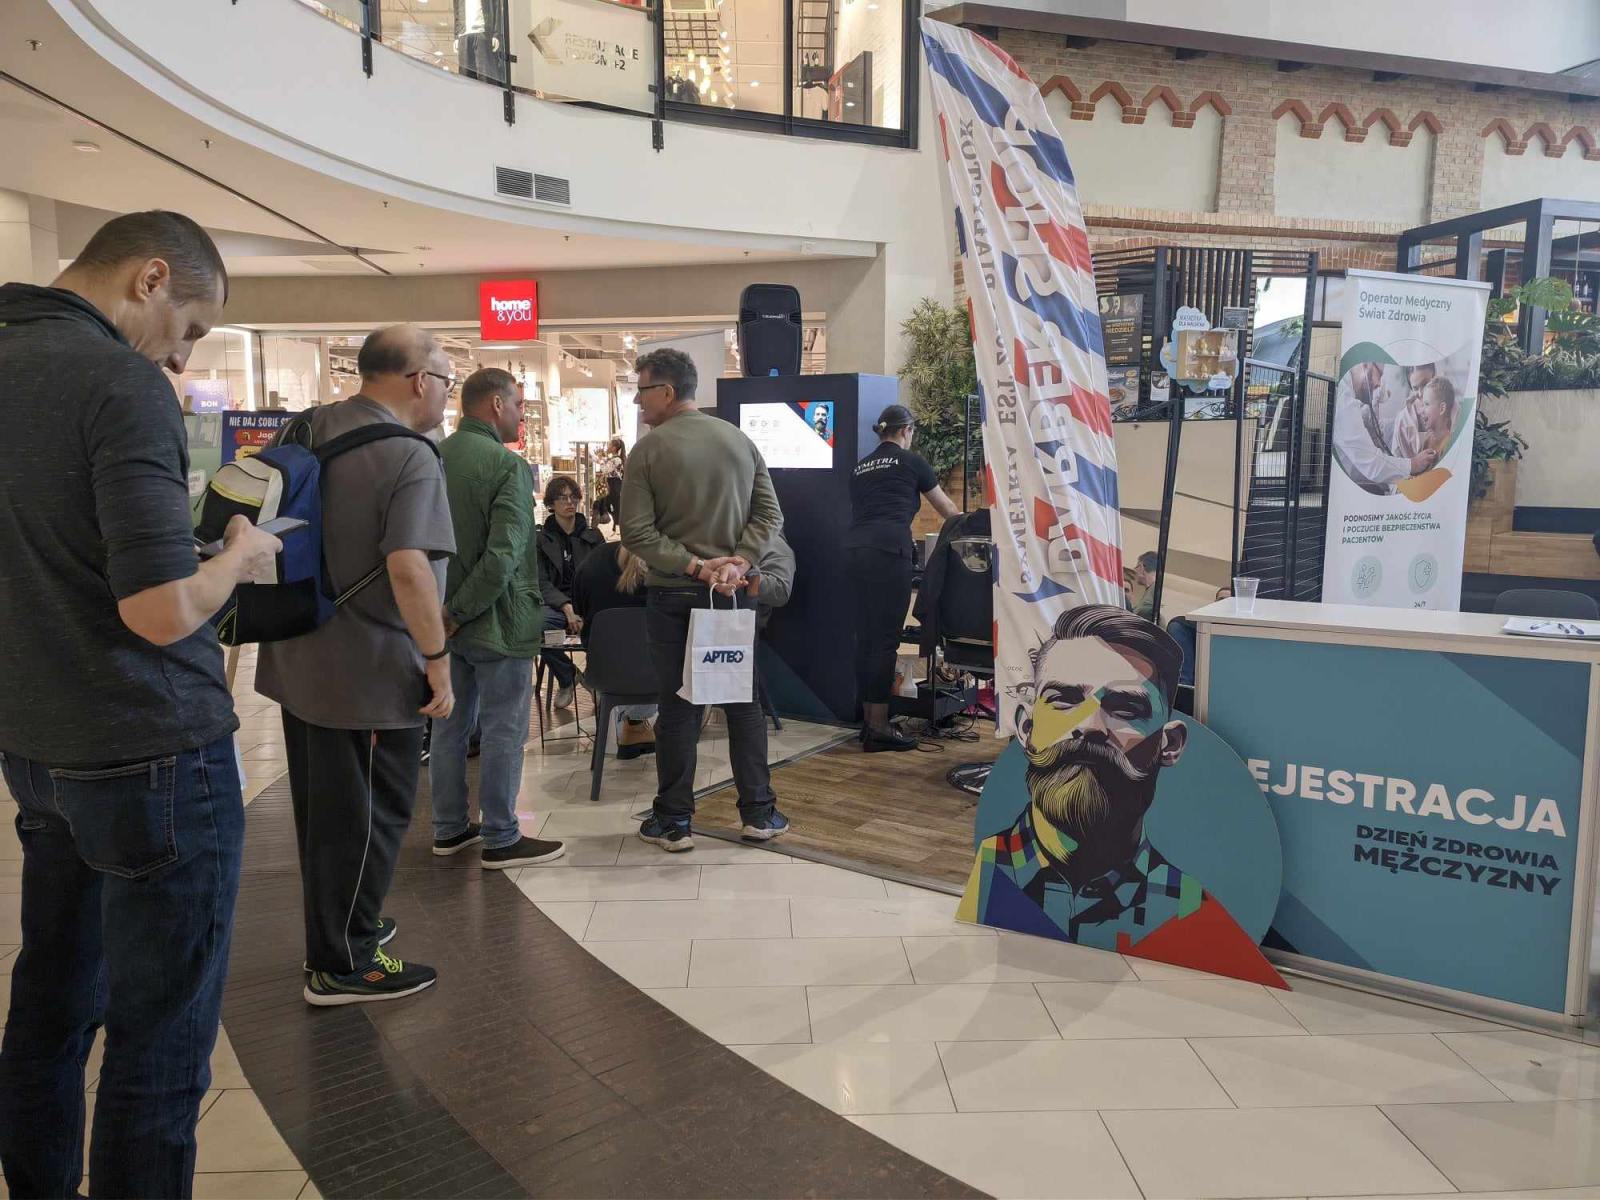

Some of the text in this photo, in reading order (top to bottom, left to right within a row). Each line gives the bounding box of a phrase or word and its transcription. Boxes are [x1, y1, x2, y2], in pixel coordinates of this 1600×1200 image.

[490, 297, 532, 312] home
[1360, 291, 1452, 311] Operator Medyczny
[1359, 304, 1426, 323] Świat Zdrowia
[229, 416, 241, 427] NIE
[242, 416, 256, 427] DAJ
[257, 417, 279, 428] SOBIE
[1343, 514, 1385, 523] PODNOSIMY
[1347, 525, 1381, 533] POCZUCIE
[1247, 758, 1567, 838] EJESTRACJA
[1356, 824, 1559, 871] DZIEŃ ZDROWIA
[1353, 845, 1562, 897] MĘŻCZYZNY
